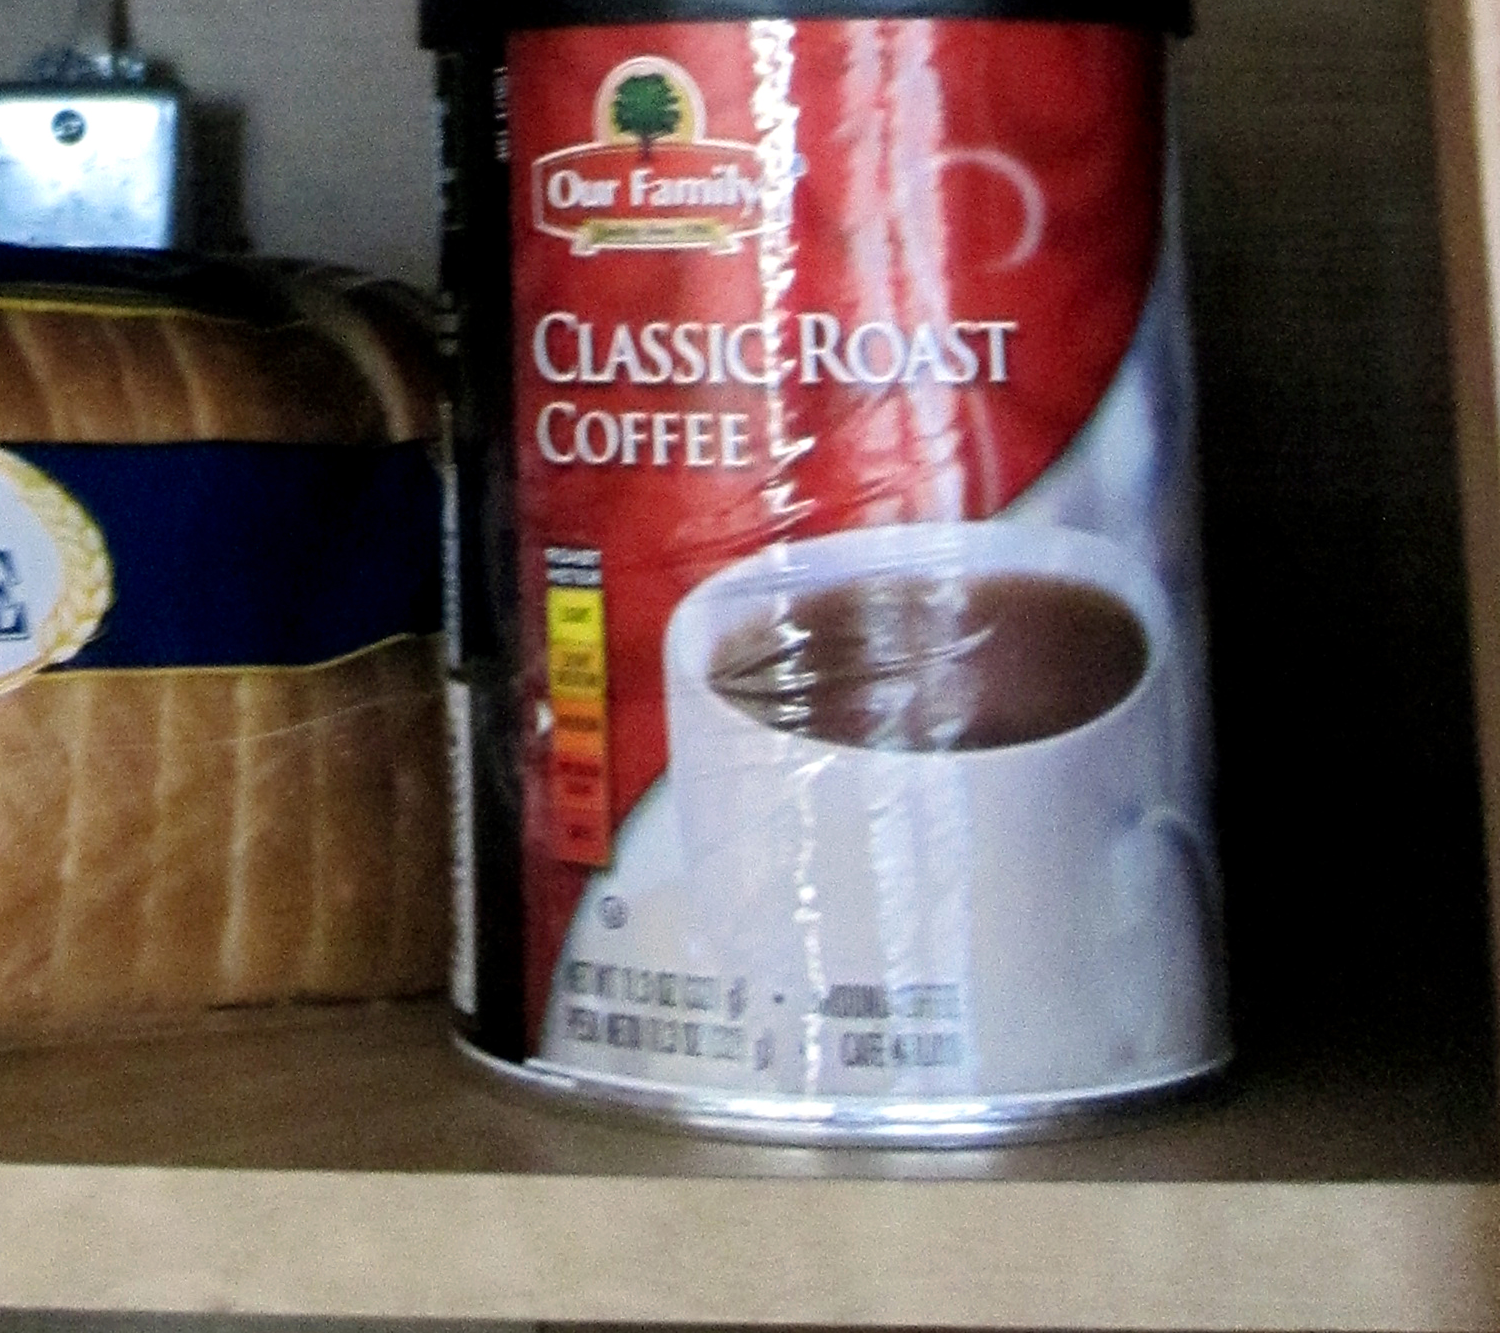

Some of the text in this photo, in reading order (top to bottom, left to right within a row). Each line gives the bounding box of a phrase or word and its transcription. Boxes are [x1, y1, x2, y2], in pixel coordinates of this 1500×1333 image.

[546, 163, 763, 218] Our Family
[532, 310, 1018, 386] CLASSIC ROAST
[535, 400, 752, 468] COFFEE
